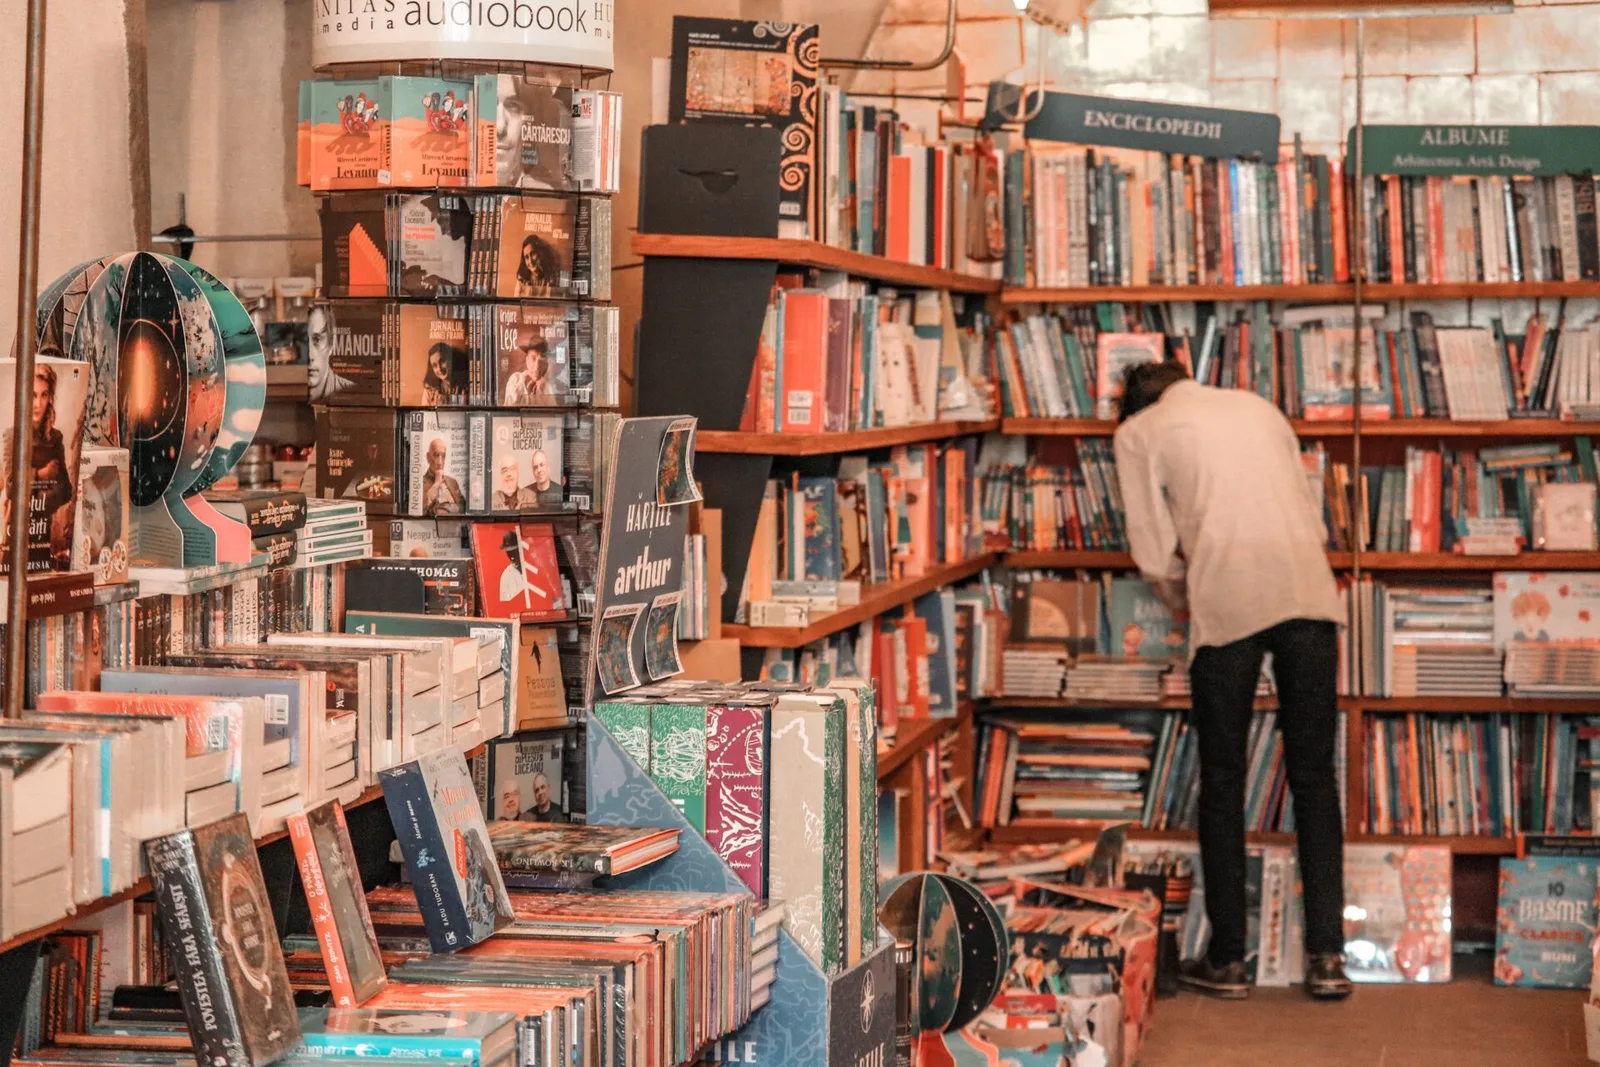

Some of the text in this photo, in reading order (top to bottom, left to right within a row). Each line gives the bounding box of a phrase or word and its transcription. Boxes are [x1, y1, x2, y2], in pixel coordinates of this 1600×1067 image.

[404, 0, 588, 33] audiobook
[1083, 109, 1222, 140] ENCICLOPEDII
[521, 122, 571, 145] CĂRTĂRESCU
[1420, 128, 1511, 145] ALBUME
[336, 166, 379, 179] Levantu
[422, 163, 468, 177] Levantu
[525, 213, 552, 223] JURNALUL
[429, 321, 465, 332] JURNALUL
[411, 414, 422, 423] 10
[410, 434, 421, 511] Neagu Djuvara
[391, 523, 401, 533] 10
[406, 530, 431, 545] Neagu
[614, 546, 672, 596] arthur
[525, 675, 556, 690] Pessoa
[413, 822, 422, 840] Maria
[516, 858, 558, 868] ROWLING
[1547, 881, 1565, 897] 10
[428, 873, 449, 926] RADU TUDORAN
[195, 971, 218, 1031] POVESTEA
